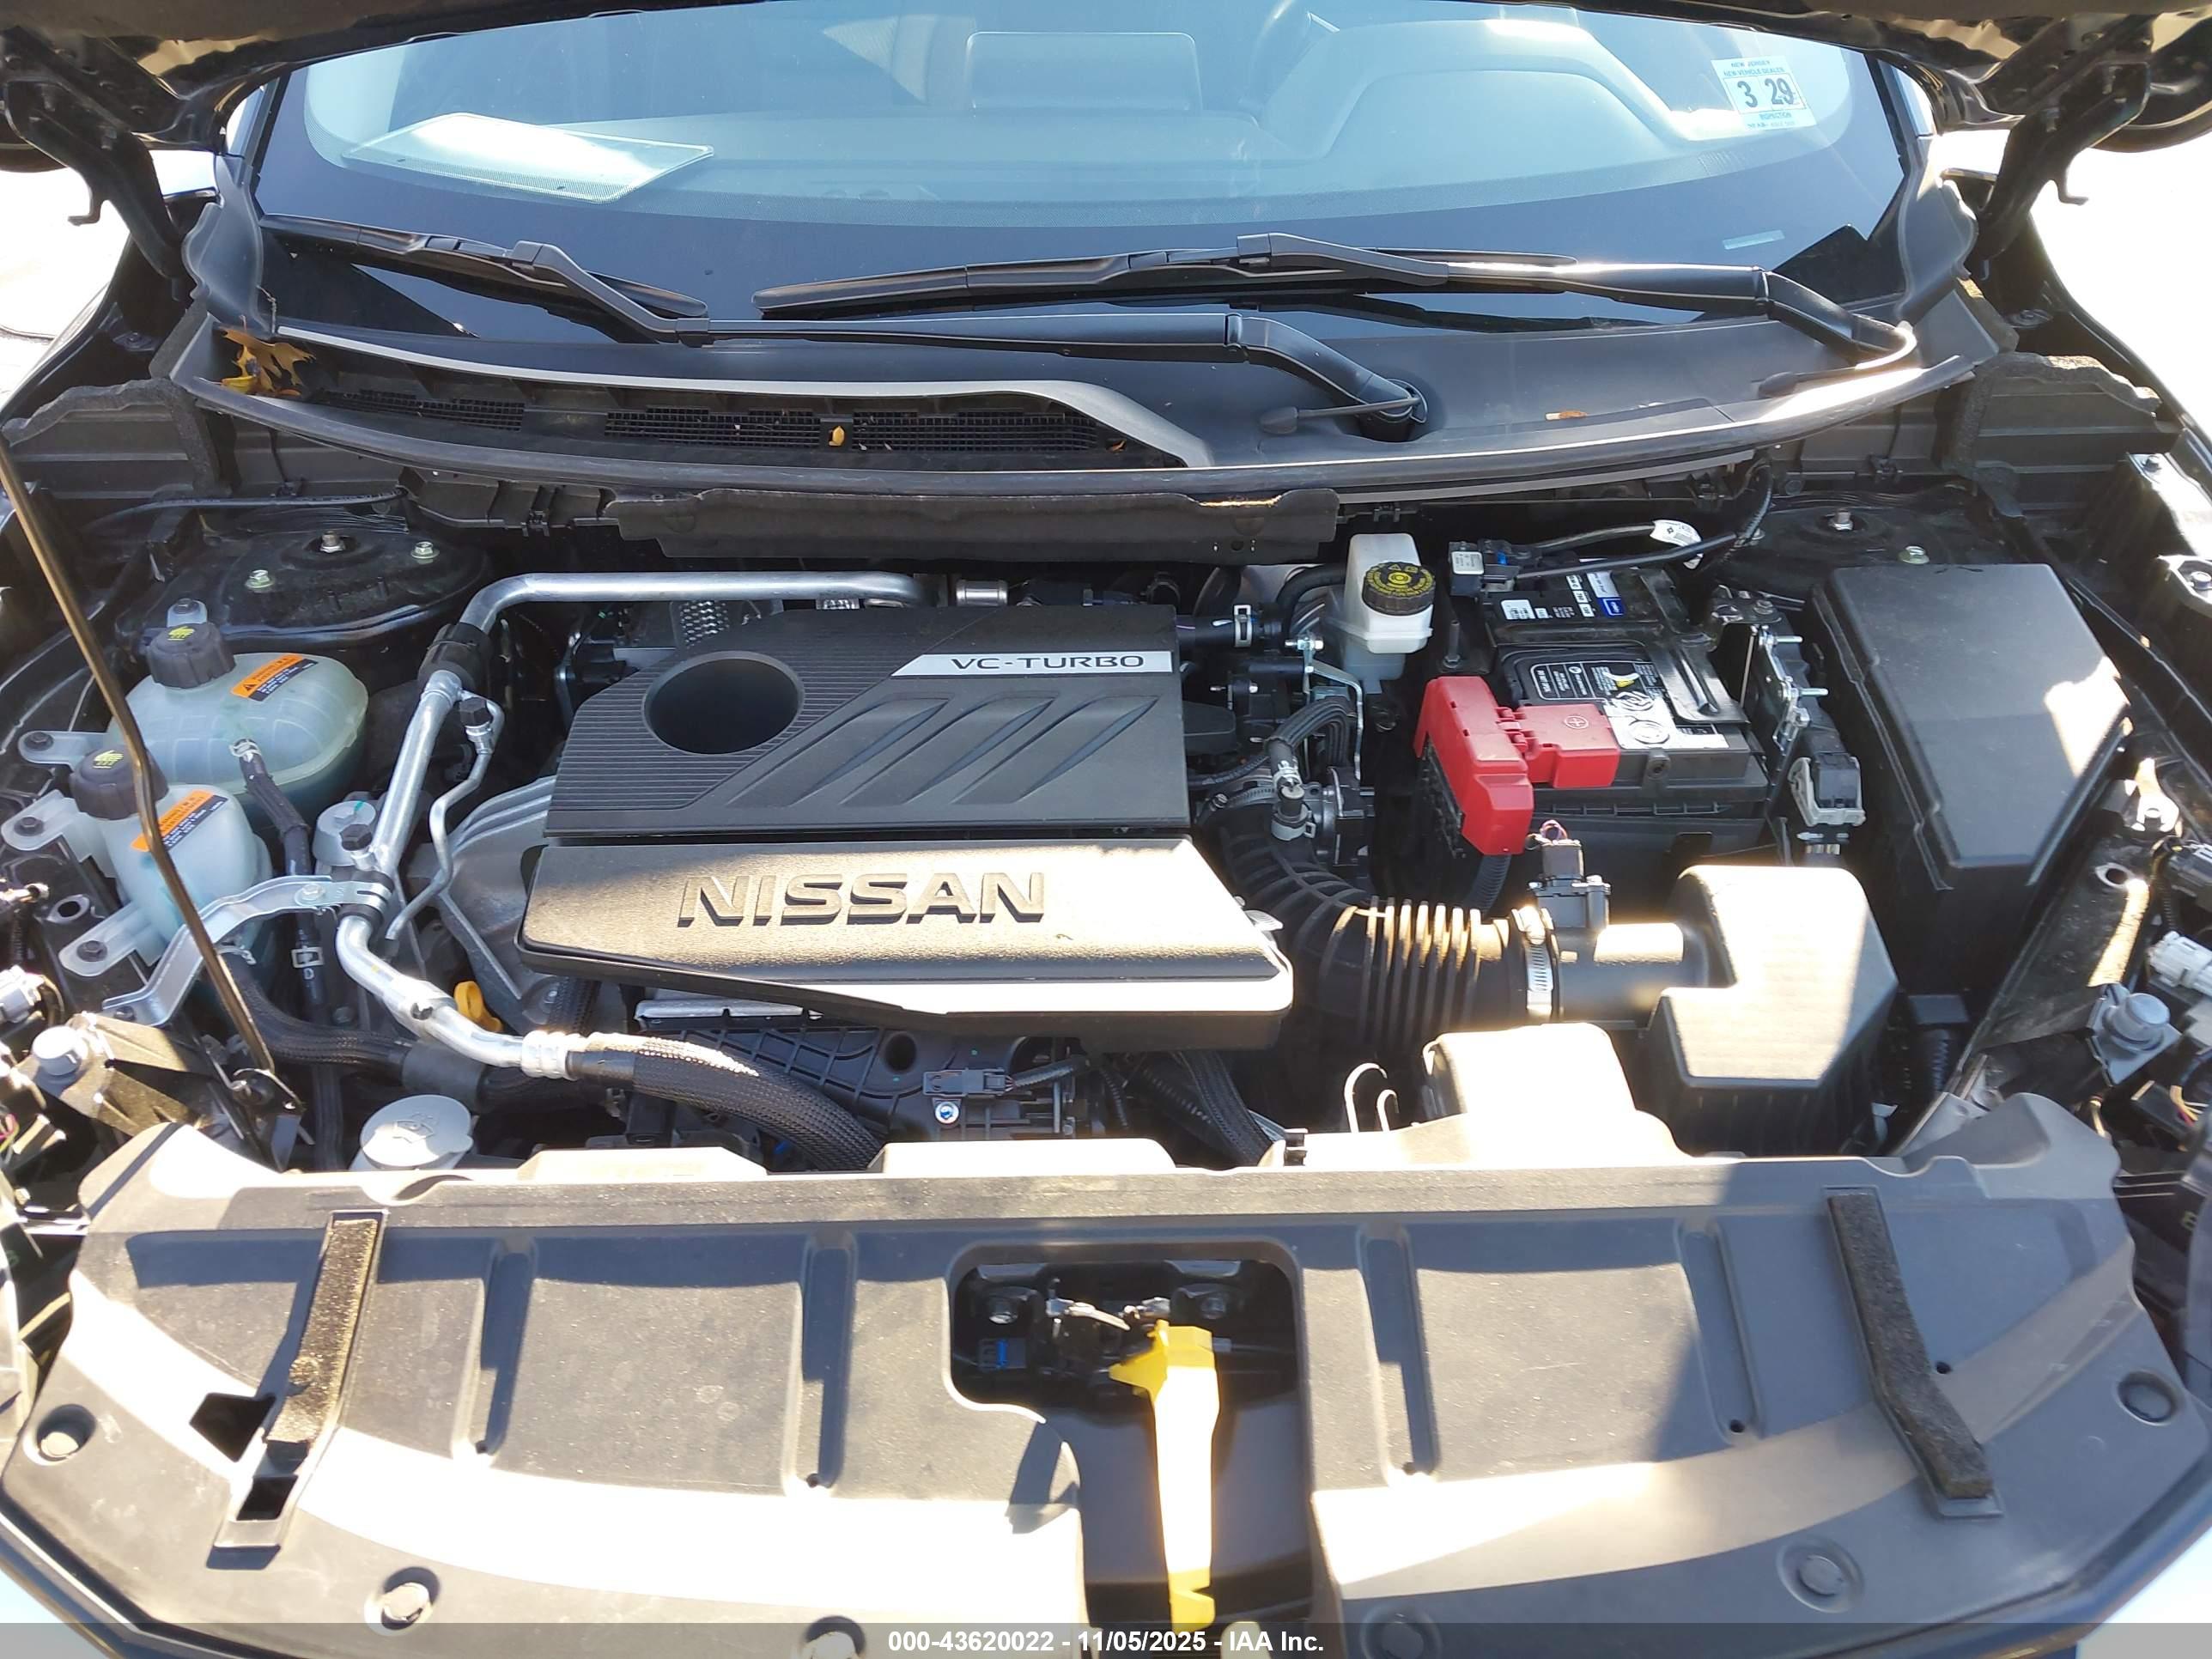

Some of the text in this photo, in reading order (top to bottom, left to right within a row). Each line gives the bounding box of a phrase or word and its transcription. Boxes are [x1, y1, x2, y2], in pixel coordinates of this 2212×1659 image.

[1737, 77, 1795, 108] 3 29
[951, 653, 1145, 672] VC-TURBO
[678, 870, 1045, 928] NISSAN
